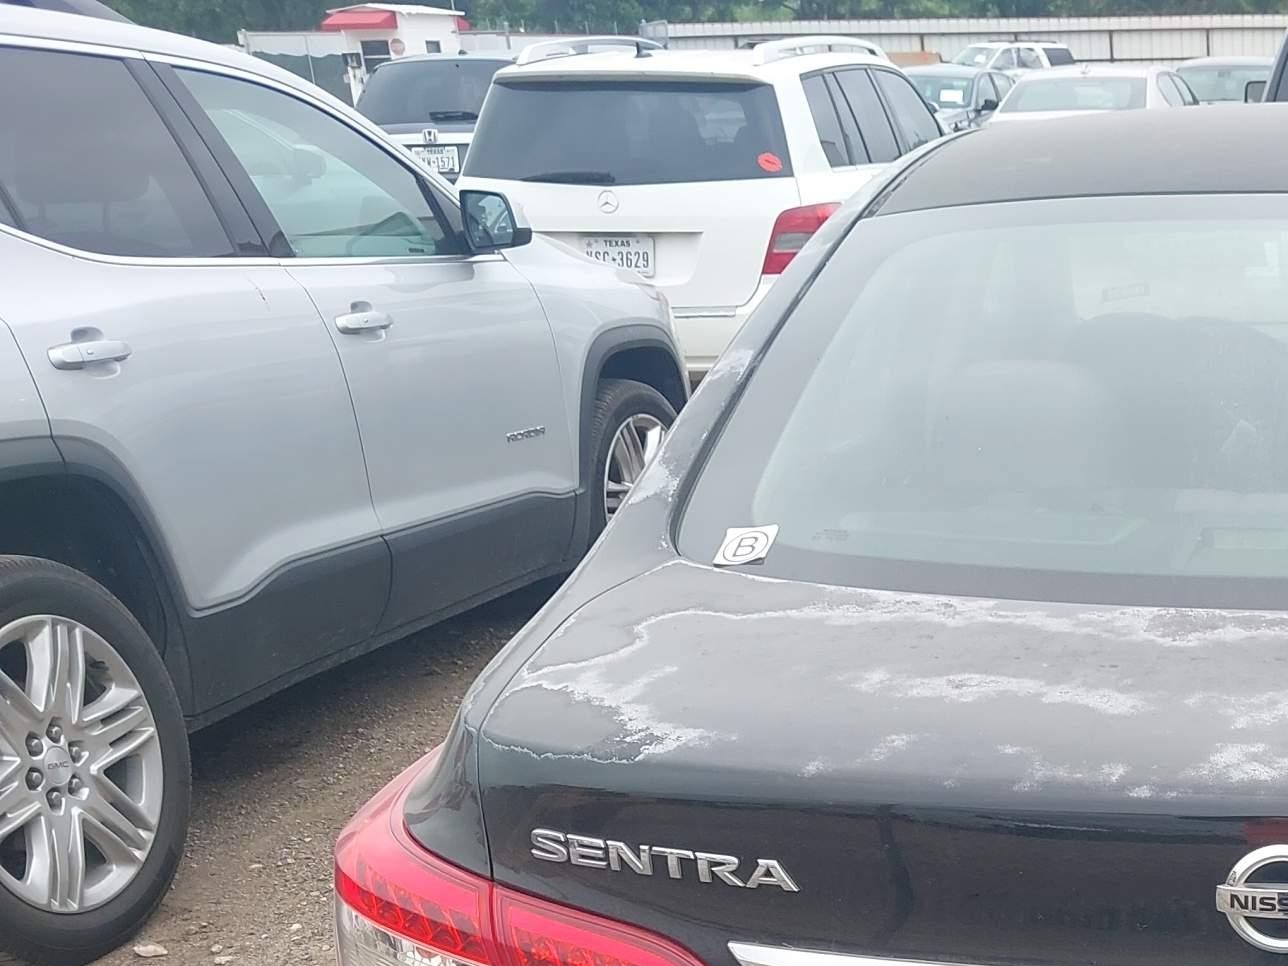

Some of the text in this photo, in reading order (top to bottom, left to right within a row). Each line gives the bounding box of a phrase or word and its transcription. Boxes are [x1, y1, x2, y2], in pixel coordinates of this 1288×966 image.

[603, 239, 631, 248] TEXAS
[732, 536, 758, 557] B
[47, 760, 70, 770] GMC
[530, 828, 800, 892] SENTRA
